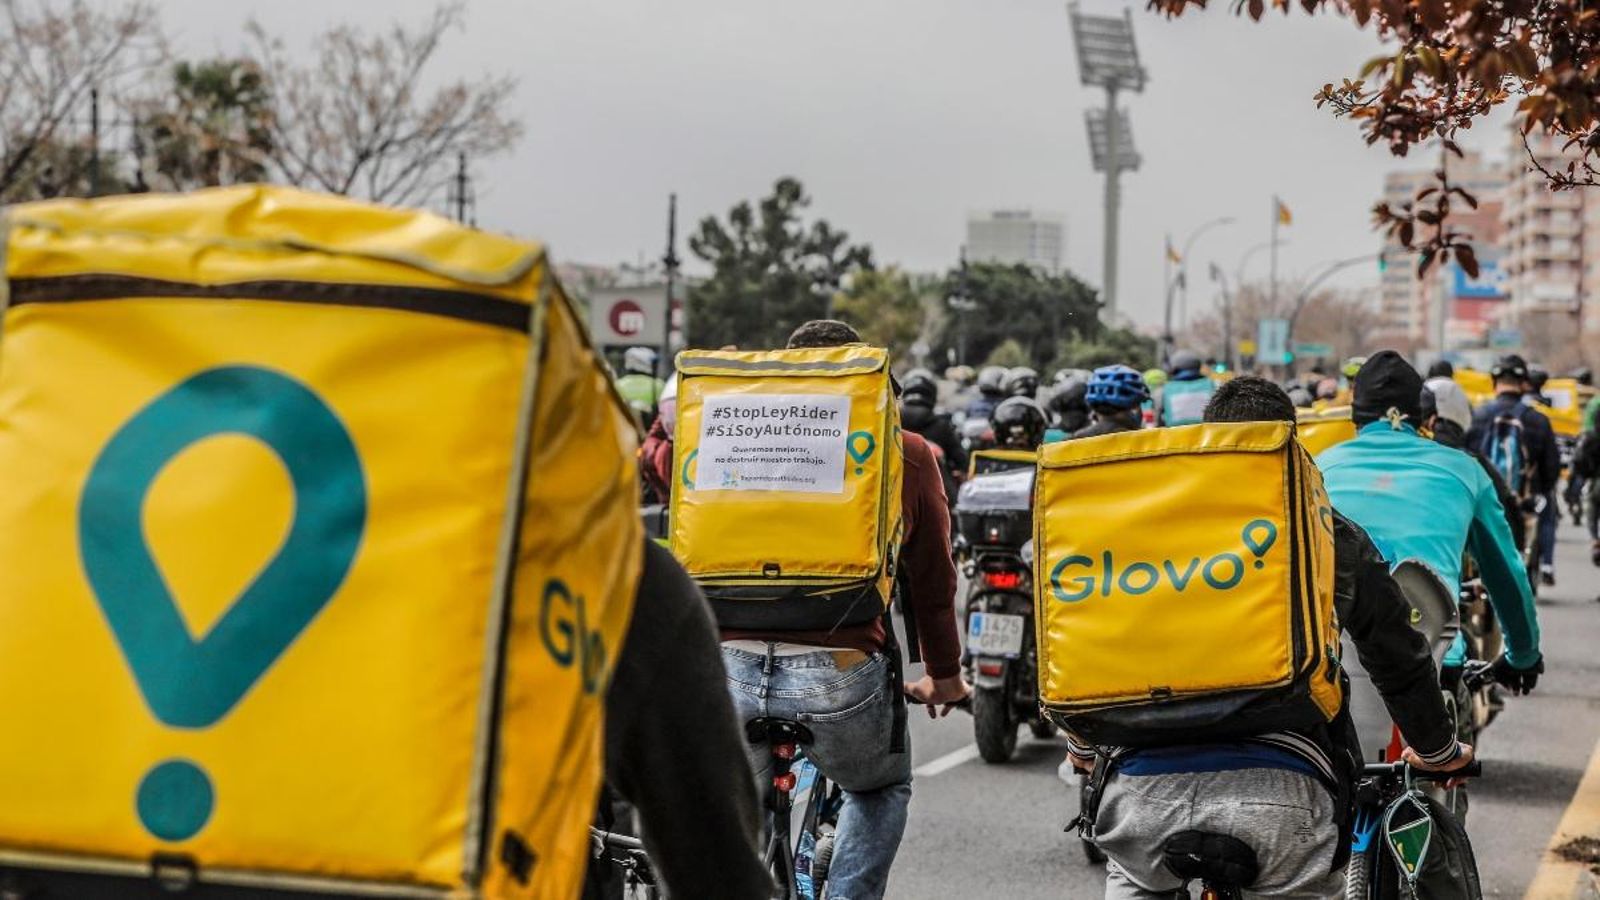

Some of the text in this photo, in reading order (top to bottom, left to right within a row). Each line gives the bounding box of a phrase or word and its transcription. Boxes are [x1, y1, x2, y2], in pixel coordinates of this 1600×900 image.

[712, 405, 839, 420] #StopLeyRider
[706, 423, 841, 439] #SíSoyAutónomo
[775, 446, 810, 454] mejorar,
[727, 456, 759, 464] destruir
[793, 456, 826, 465] trabajo.
[1050, 550, 1245, 602] Glovo
[984, 616, 1020, 635] 1475
[980, 632, 1010, 649] GPP
